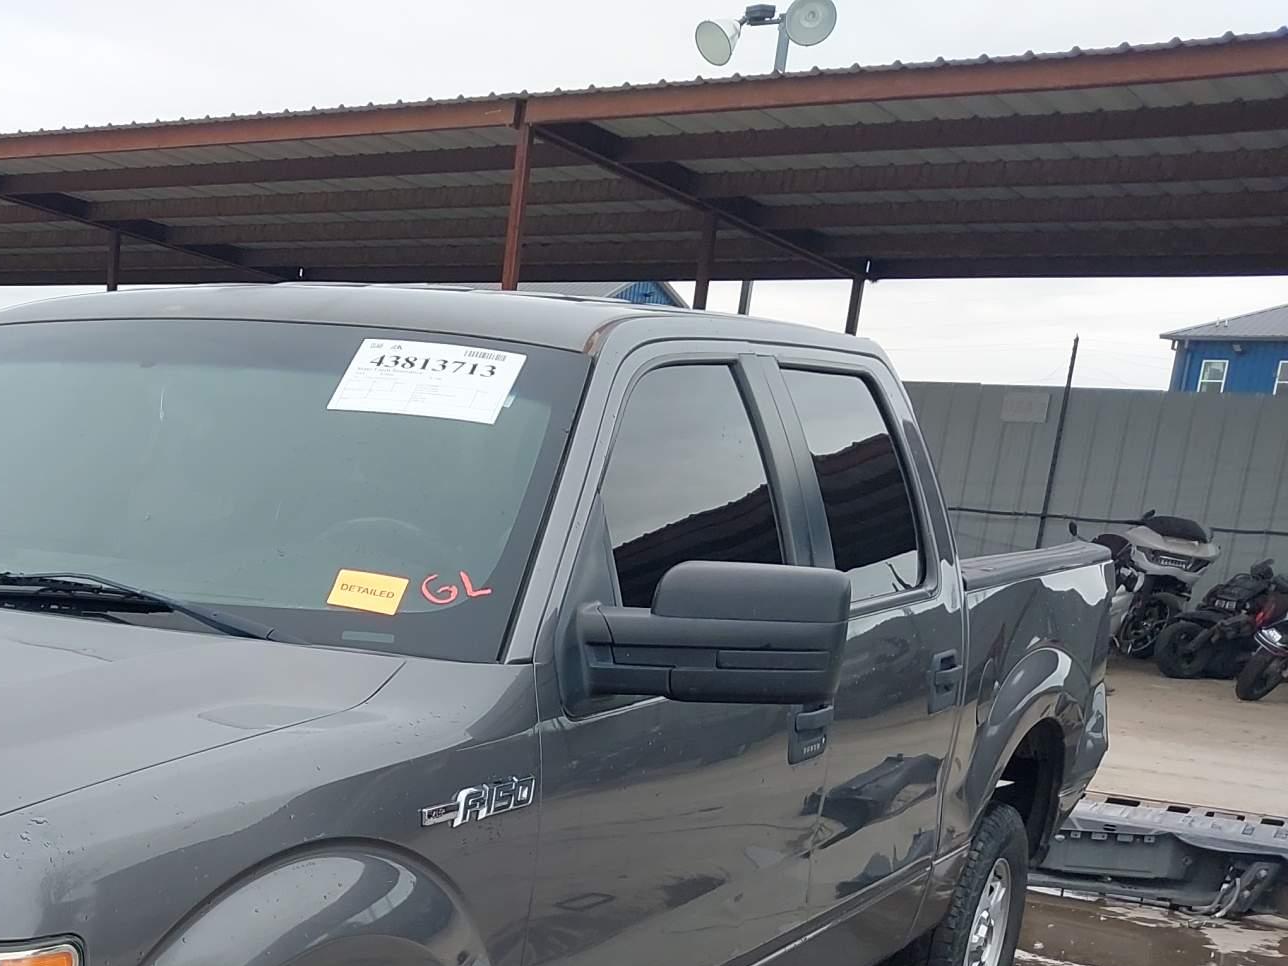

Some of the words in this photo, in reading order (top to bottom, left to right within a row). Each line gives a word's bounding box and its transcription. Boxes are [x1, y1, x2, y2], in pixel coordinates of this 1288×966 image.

[368, 353, 497, 378] 43813713
[340, 583, 395, 599] DETAILED
[420, 569, 492, 604] GL
